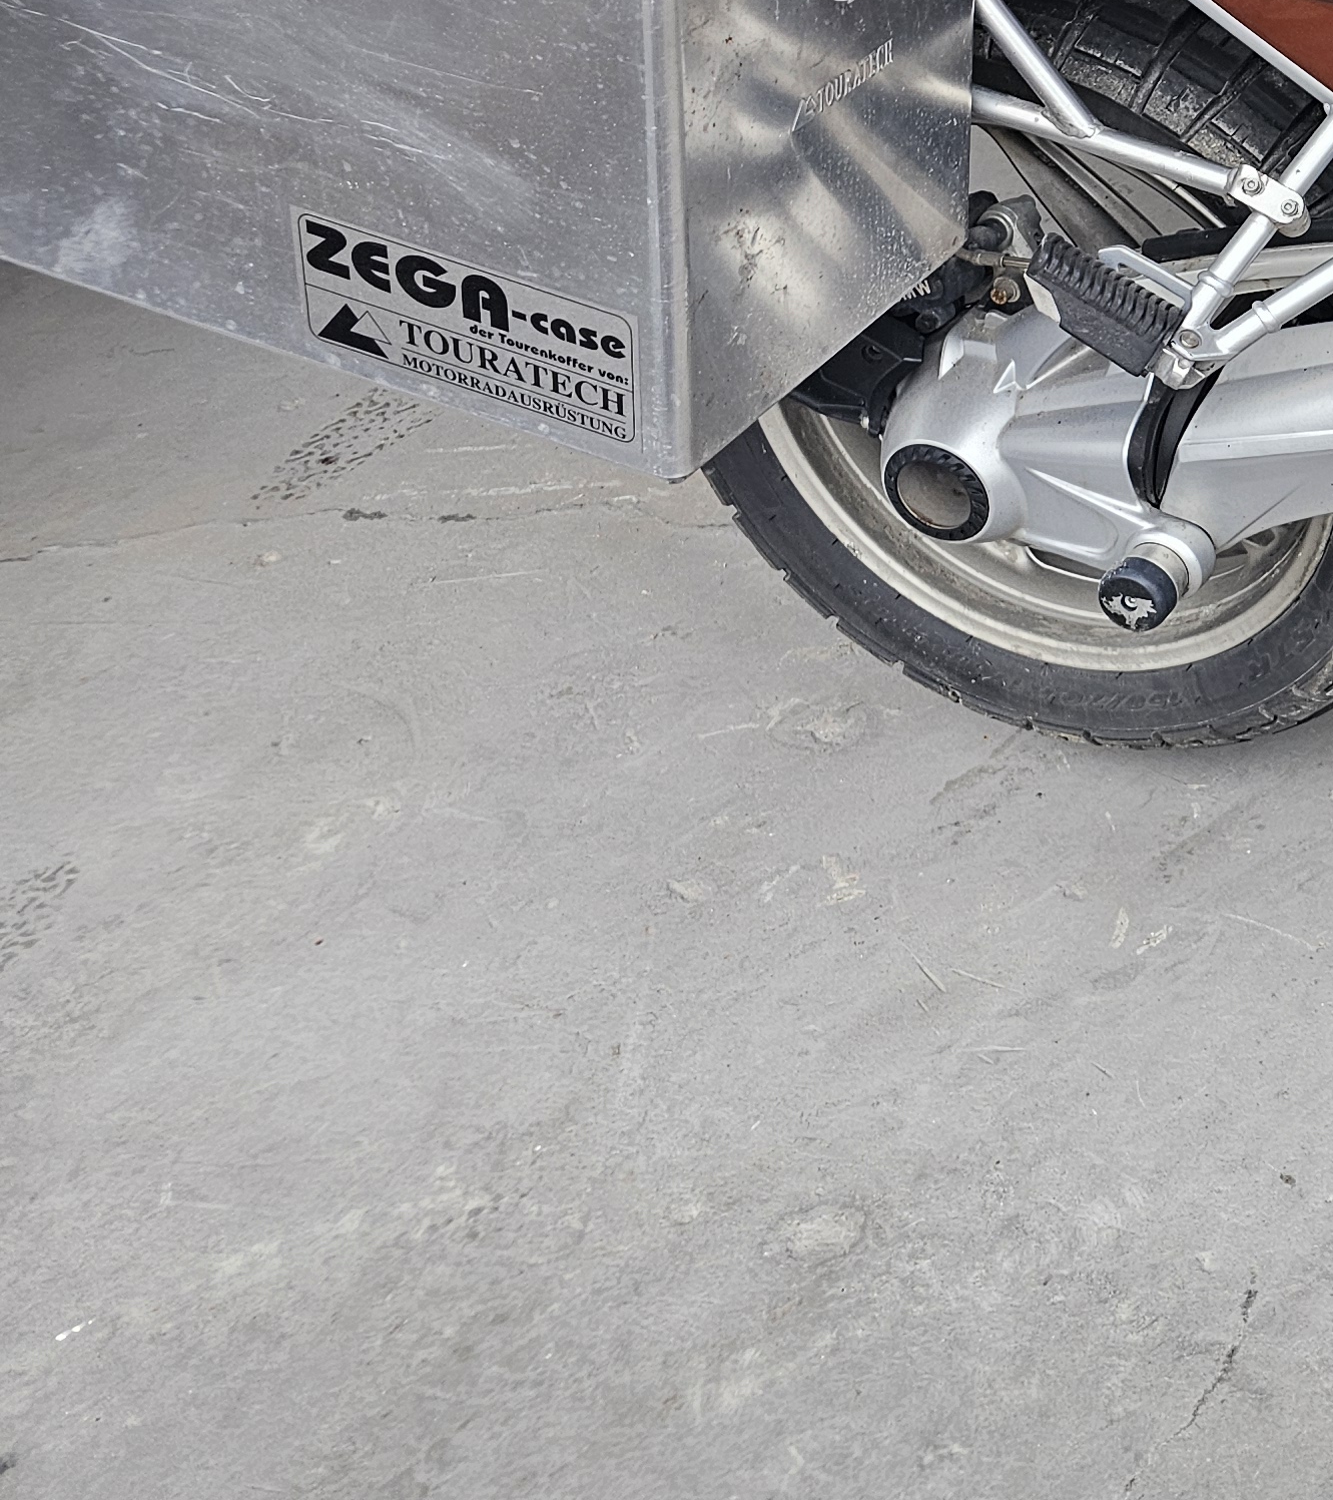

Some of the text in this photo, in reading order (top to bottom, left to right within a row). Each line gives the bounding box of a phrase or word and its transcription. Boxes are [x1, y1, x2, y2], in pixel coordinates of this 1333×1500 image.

[399, 319, 627, 418] TOURATECH
[402, 353, 627, 441] MOTORRADAUSRÜSTUNG
[469, 324, 630, 386] der Tourenkoffer von:
